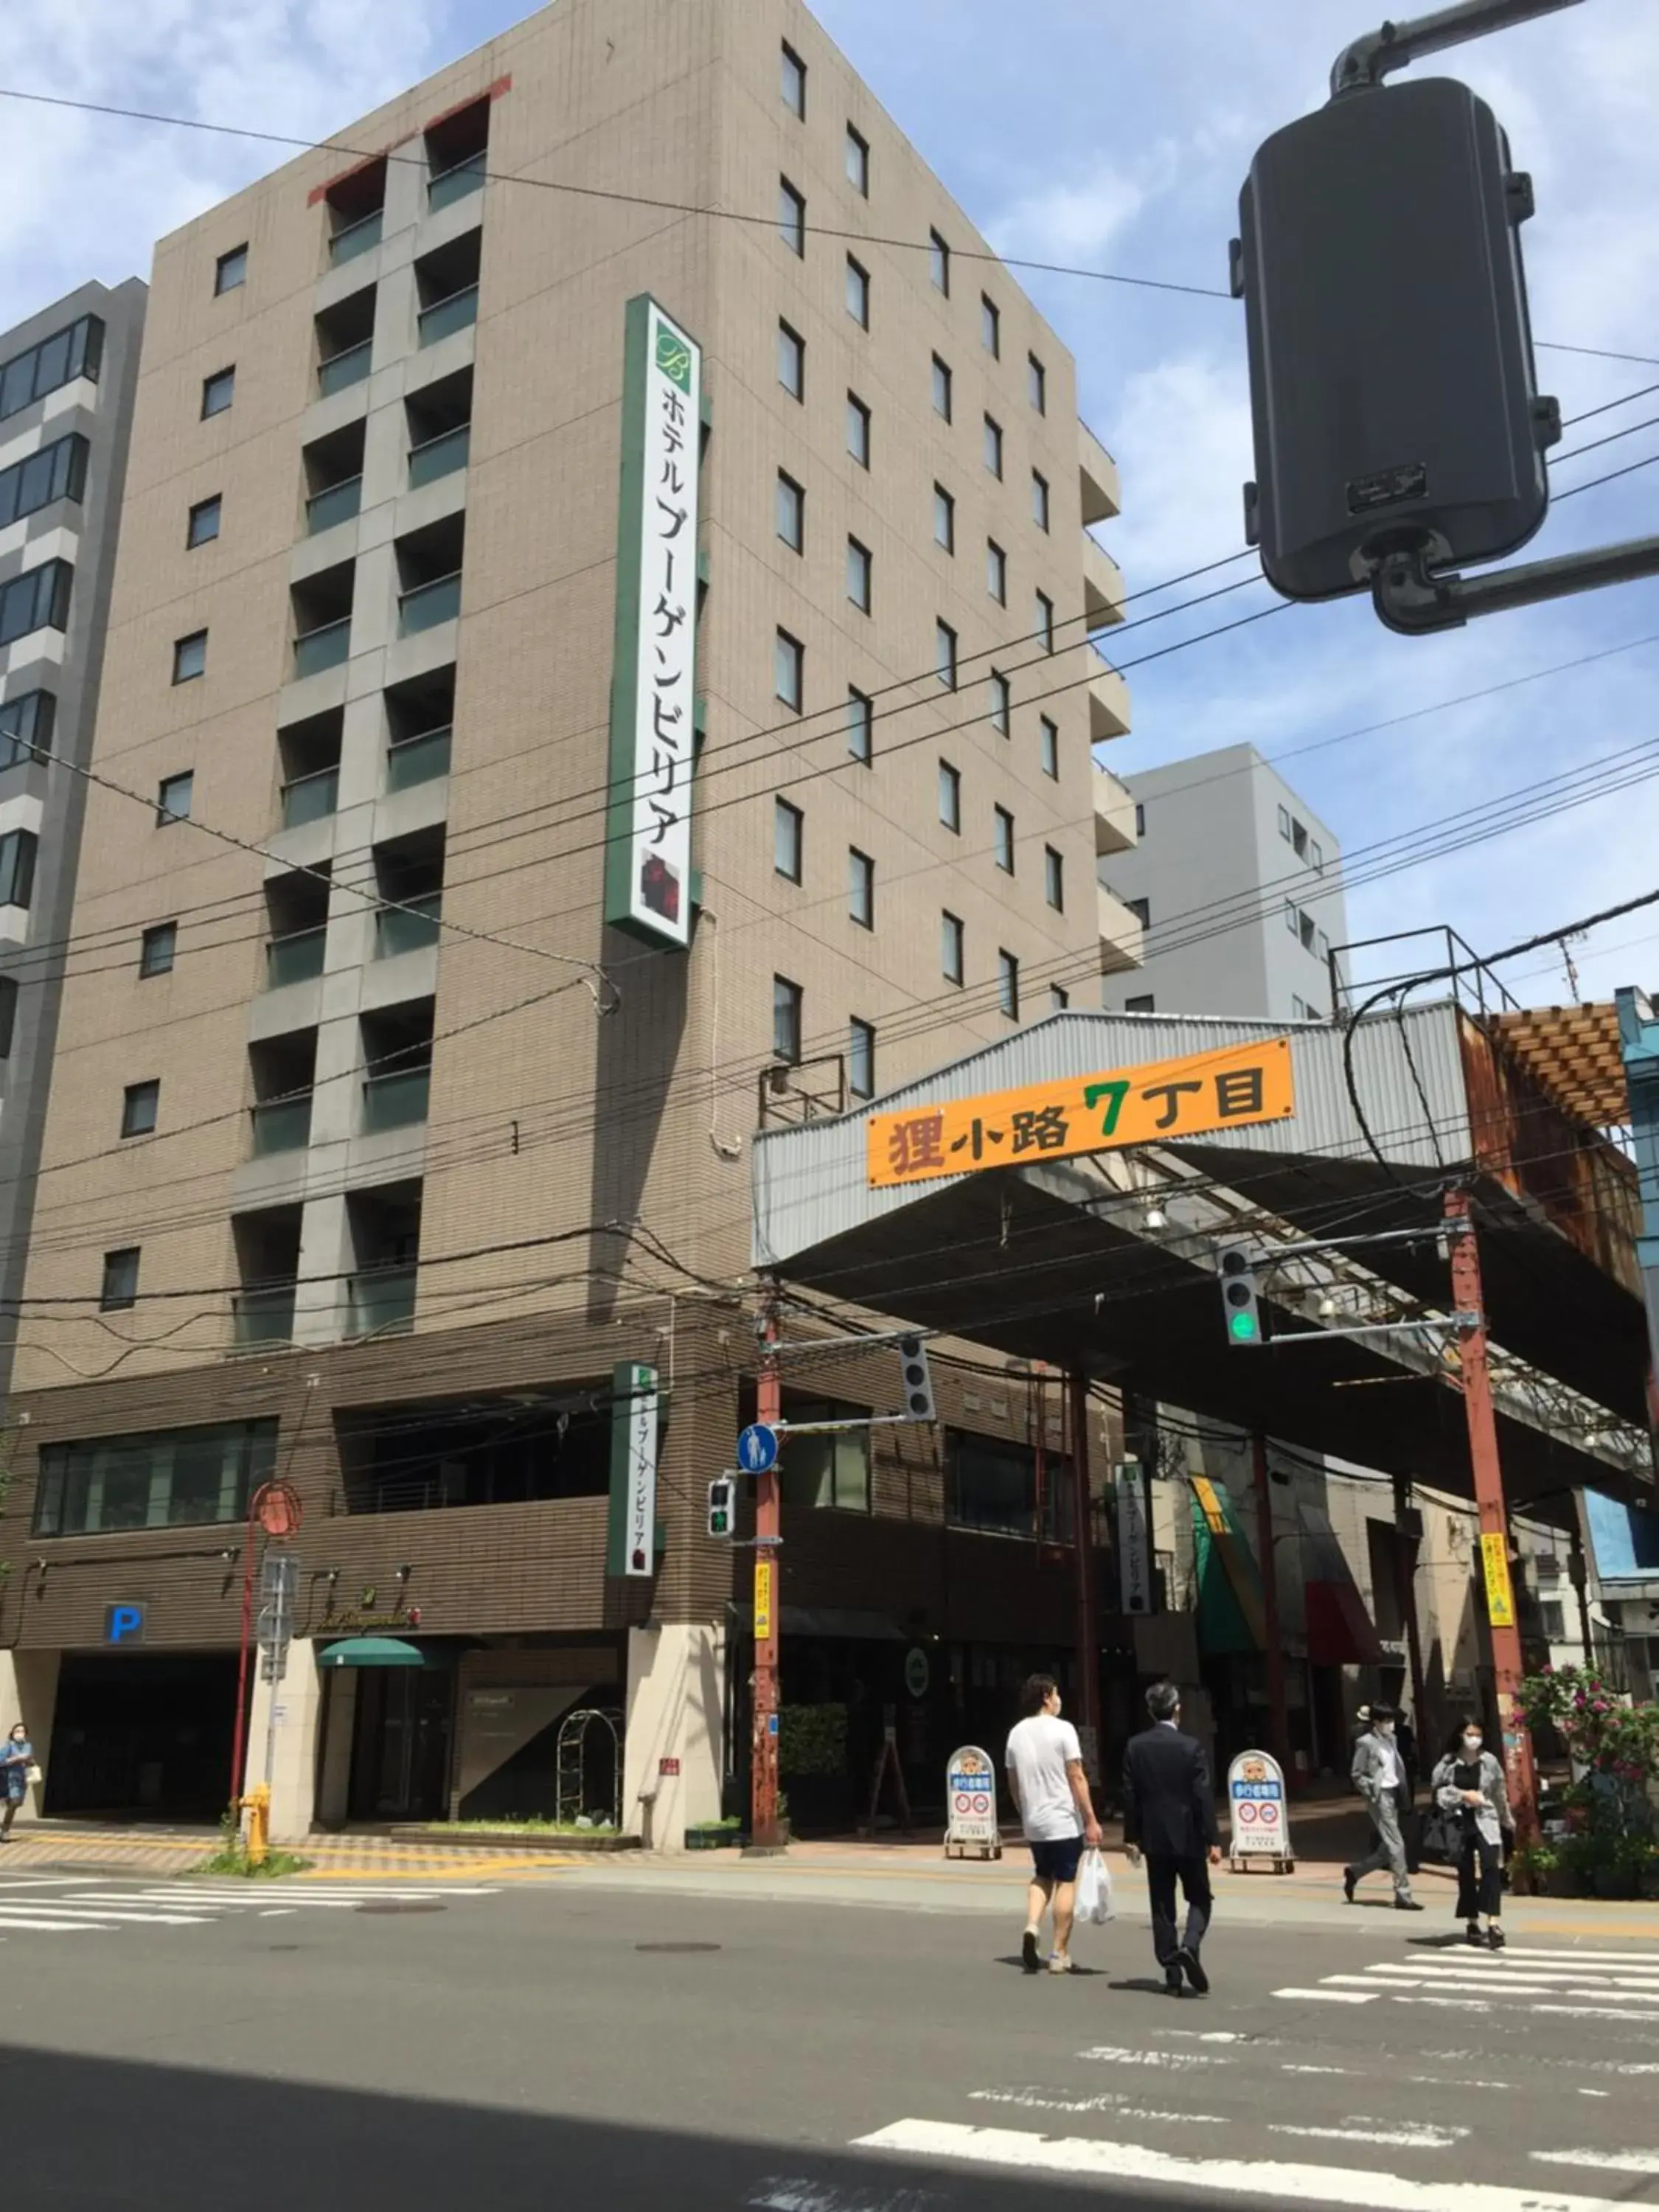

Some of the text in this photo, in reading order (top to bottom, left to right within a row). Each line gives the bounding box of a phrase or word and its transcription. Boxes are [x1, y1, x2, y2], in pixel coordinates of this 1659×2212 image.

[649, 388, 689, 845] ホテルブーゲンビリア
[888, 1067, 1263, 1176] 狸小路7丁目
[110, 1607, 140, 1644] P
